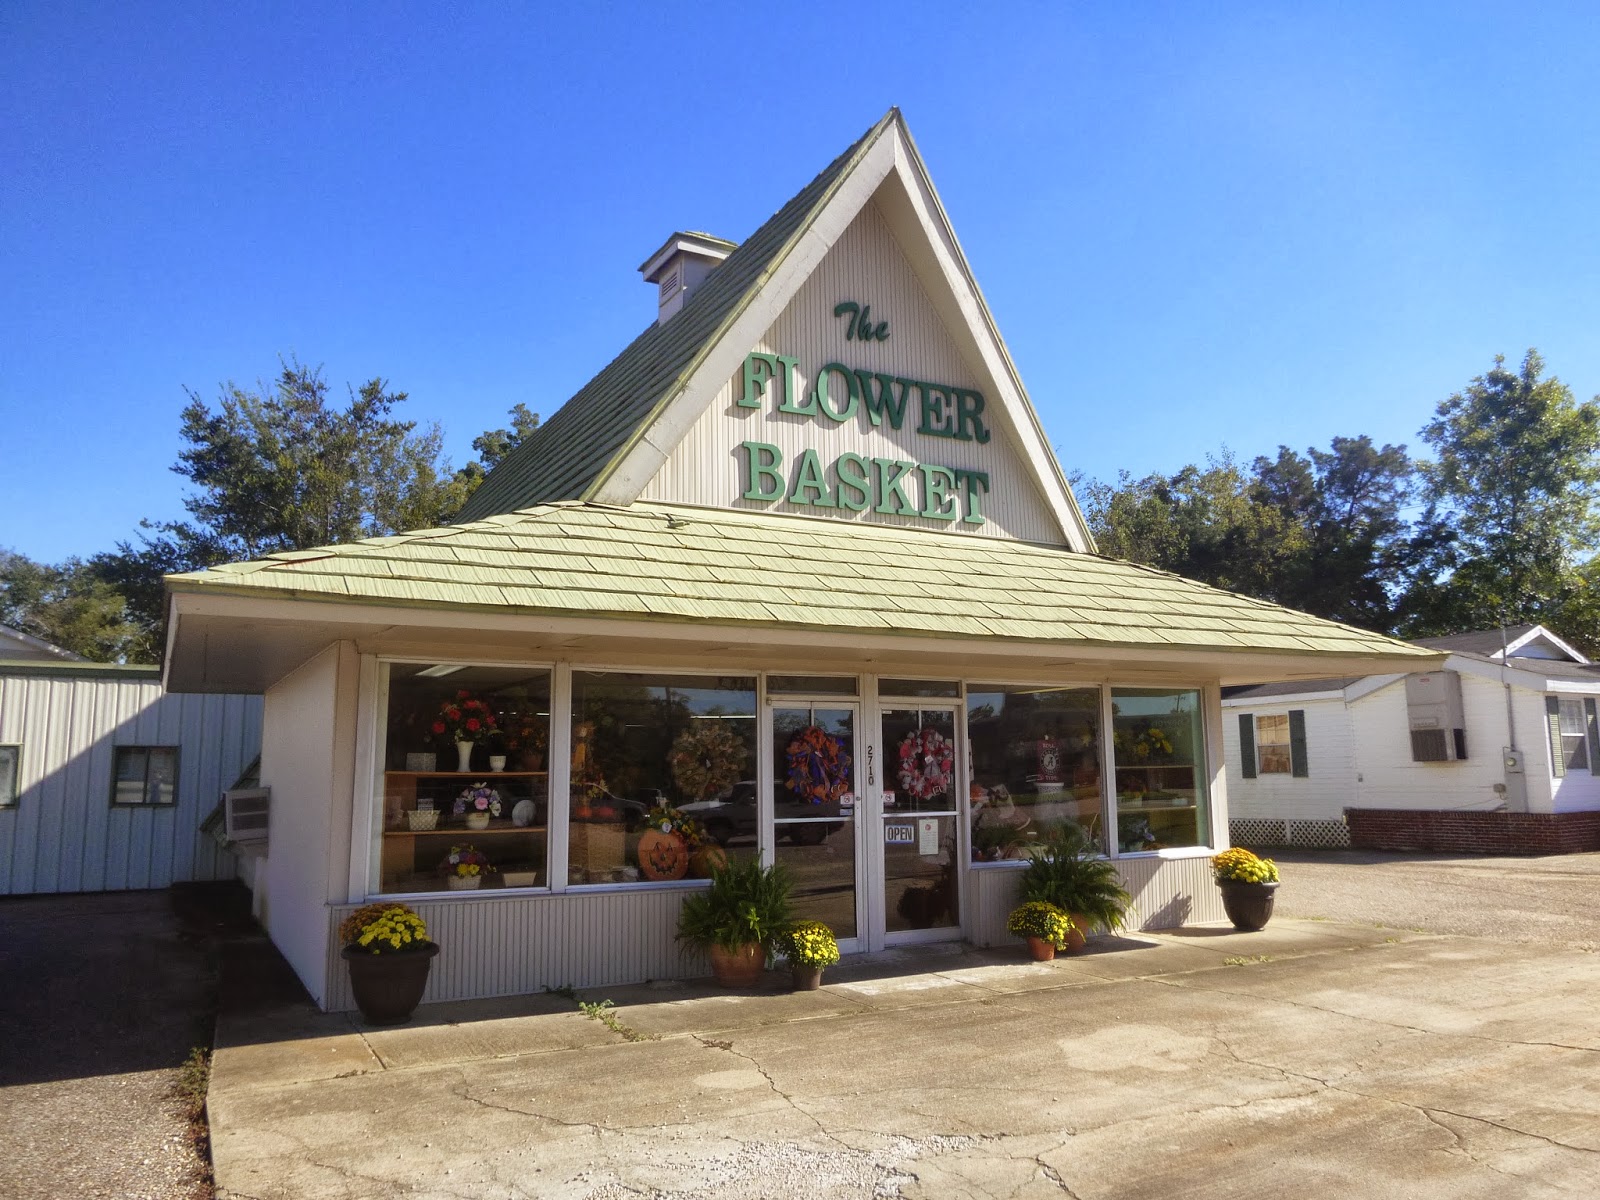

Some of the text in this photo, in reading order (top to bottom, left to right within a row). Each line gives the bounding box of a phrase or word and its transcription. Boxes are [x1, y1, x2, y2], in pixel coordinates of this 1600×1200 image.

[834, 302, 890, 341] The
[737, 351, 990, 444] FLOWER
[742, 441, 989, 524] BASKET
[887, 826, 912, 841] OPEN
